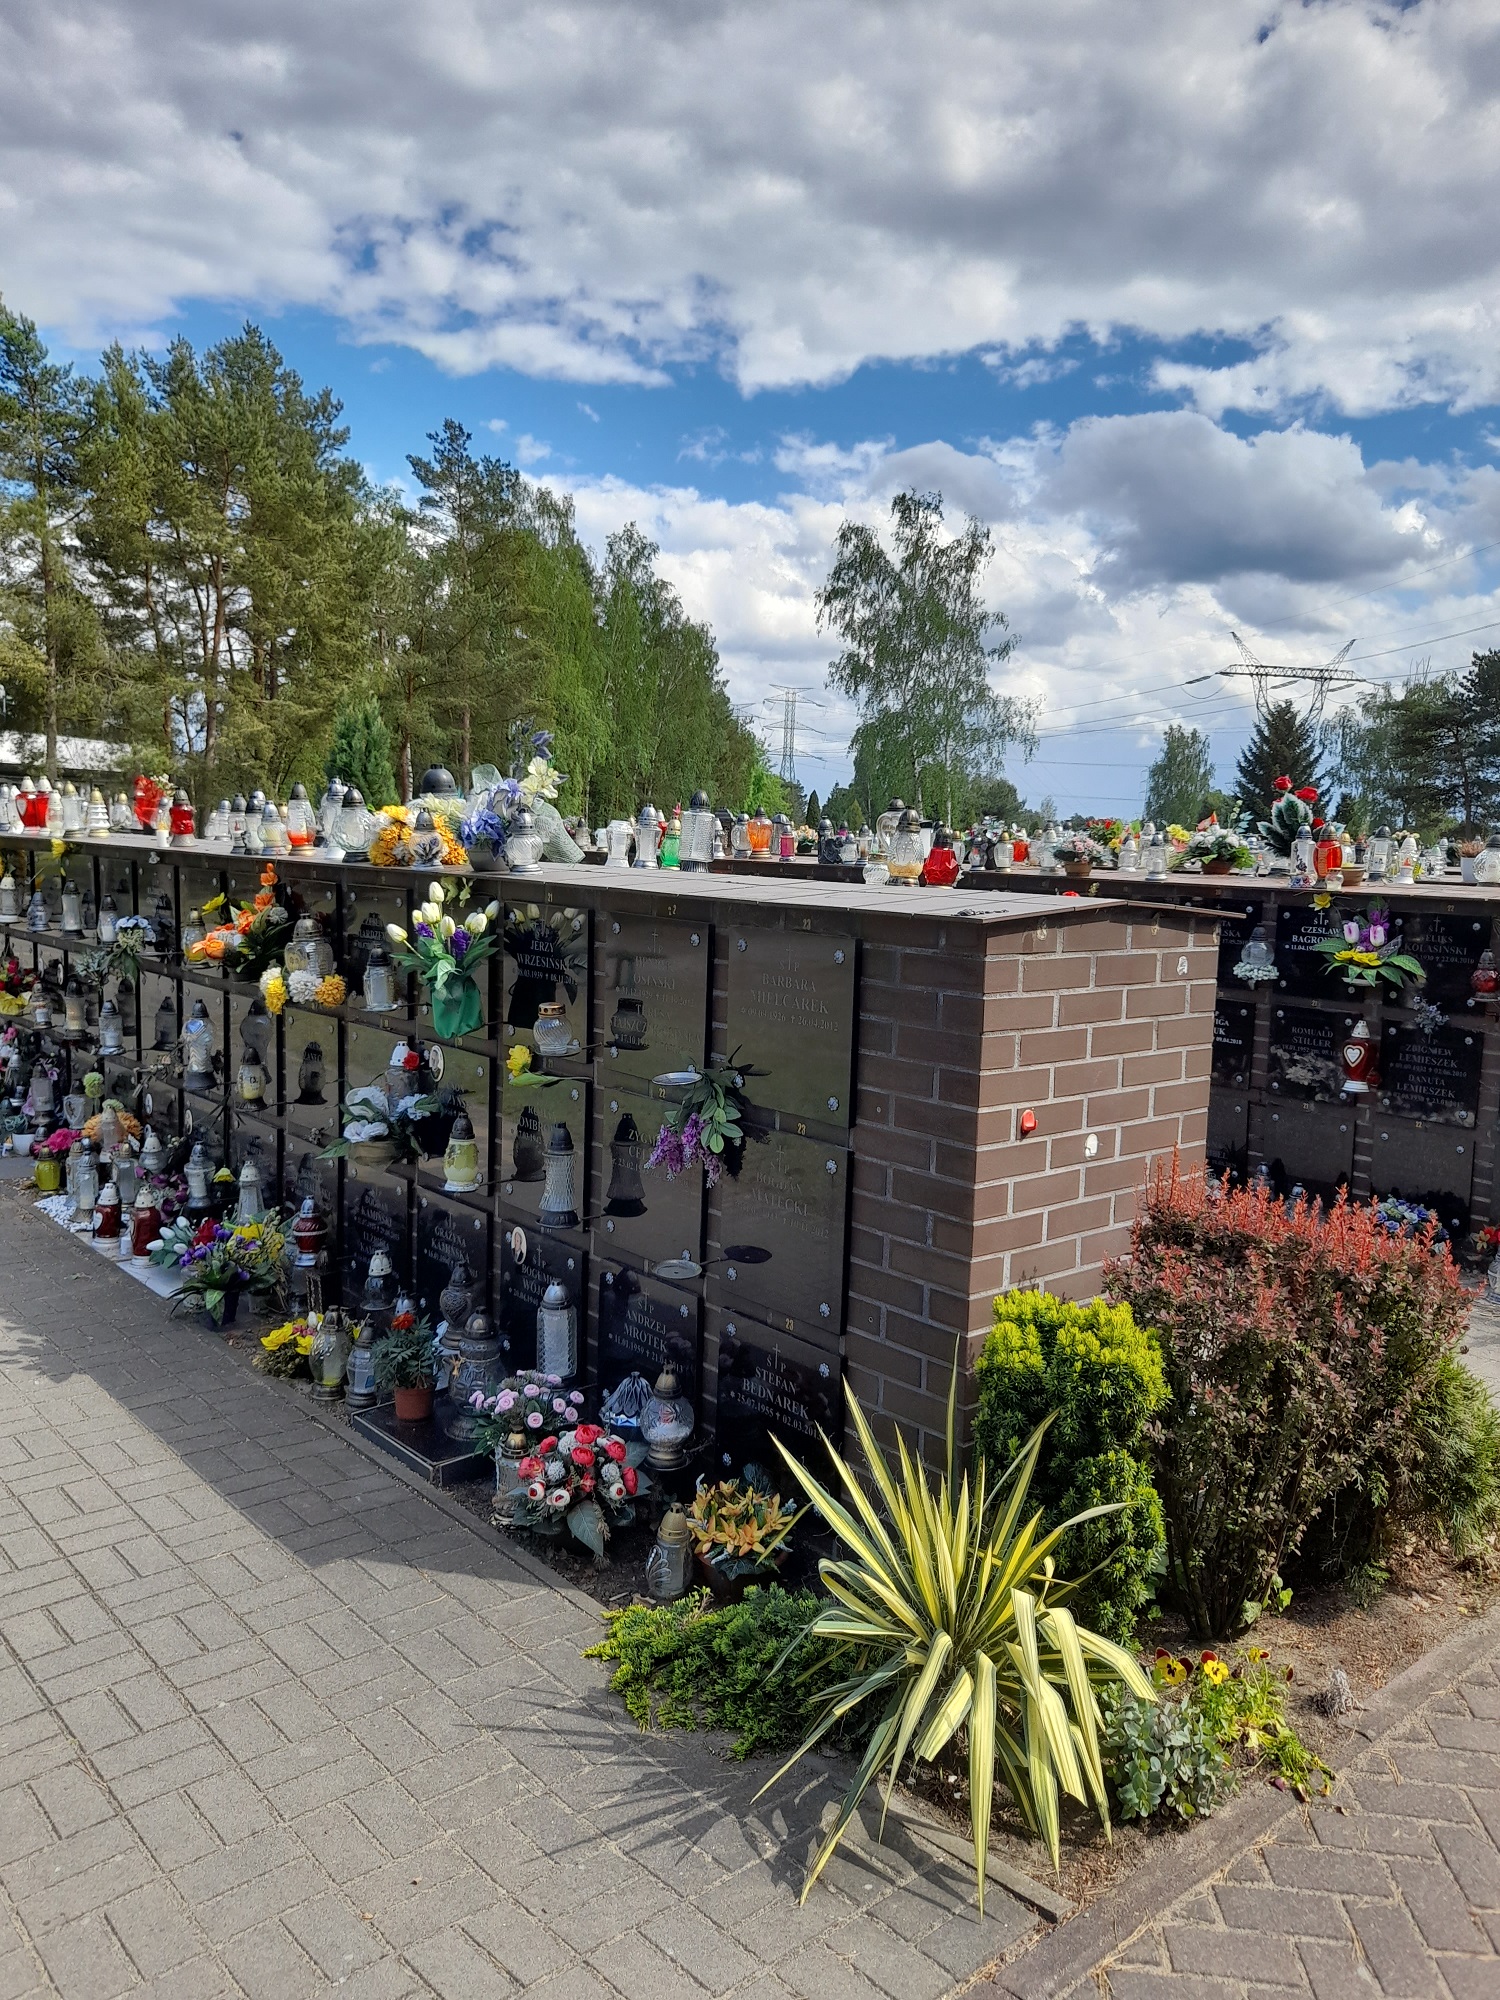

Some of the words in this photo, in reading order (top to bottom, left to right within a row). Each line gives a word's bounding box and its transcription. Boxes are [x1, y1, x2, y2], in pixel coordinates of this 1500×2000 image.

[530, 940, 554, 953] JERZY
[762, 973, 817, 993] BARBARA
[751, 989, 829, 1015] MIELCAREK
[1291, 1026, 1334, 1038] ROMUALD
[1292, 1036, 1331, 1048] STILLER
[1399, 1053, 1458, 1068] LEMIESZEK
[1396, 1082, 1456, 1099] LEMIESZEK
[1408, 1074, 1446, 1087] DANUTA
[625, 1309, 667, 1336] ANDRZEJ
[622, 1322, 669, 1354] MROTEK
[755, 1365, 797, 1396] STEFAN
[736, 1392, 775, 1419] 25.07.1955
[742, 1377, 810, 1421] BEDNAREK
